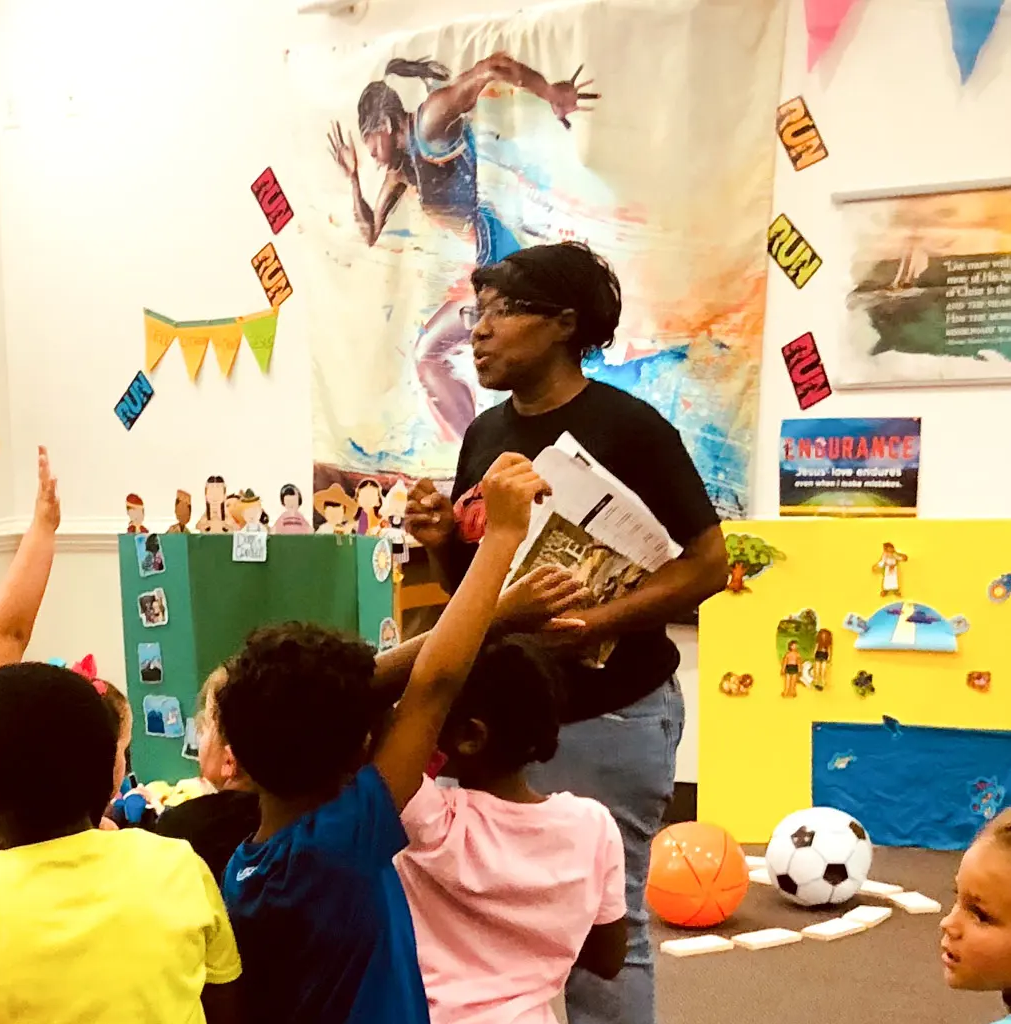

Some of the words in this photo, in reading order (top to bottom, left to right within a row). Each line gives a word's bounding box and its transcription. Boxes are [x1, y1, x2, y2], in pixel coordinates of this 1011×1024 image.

[777, 97, 828, 170] RUN
[252, 167, 293, 234] RUN
[252, 243, 293, 306] RUN
[768, 214, 822, 288] RUN
[114, 371, 154, 431] RUN
[782, 332, 831, 409] RUN
[783, 435, 915, 461] ENDURANCE
[831, 467, 854, 477] love
[856, 467, 902, 477] endures
[794, 480, 814, 488] even
[815, 479, 836, 488] when
[841, 479, 863, 488] make
